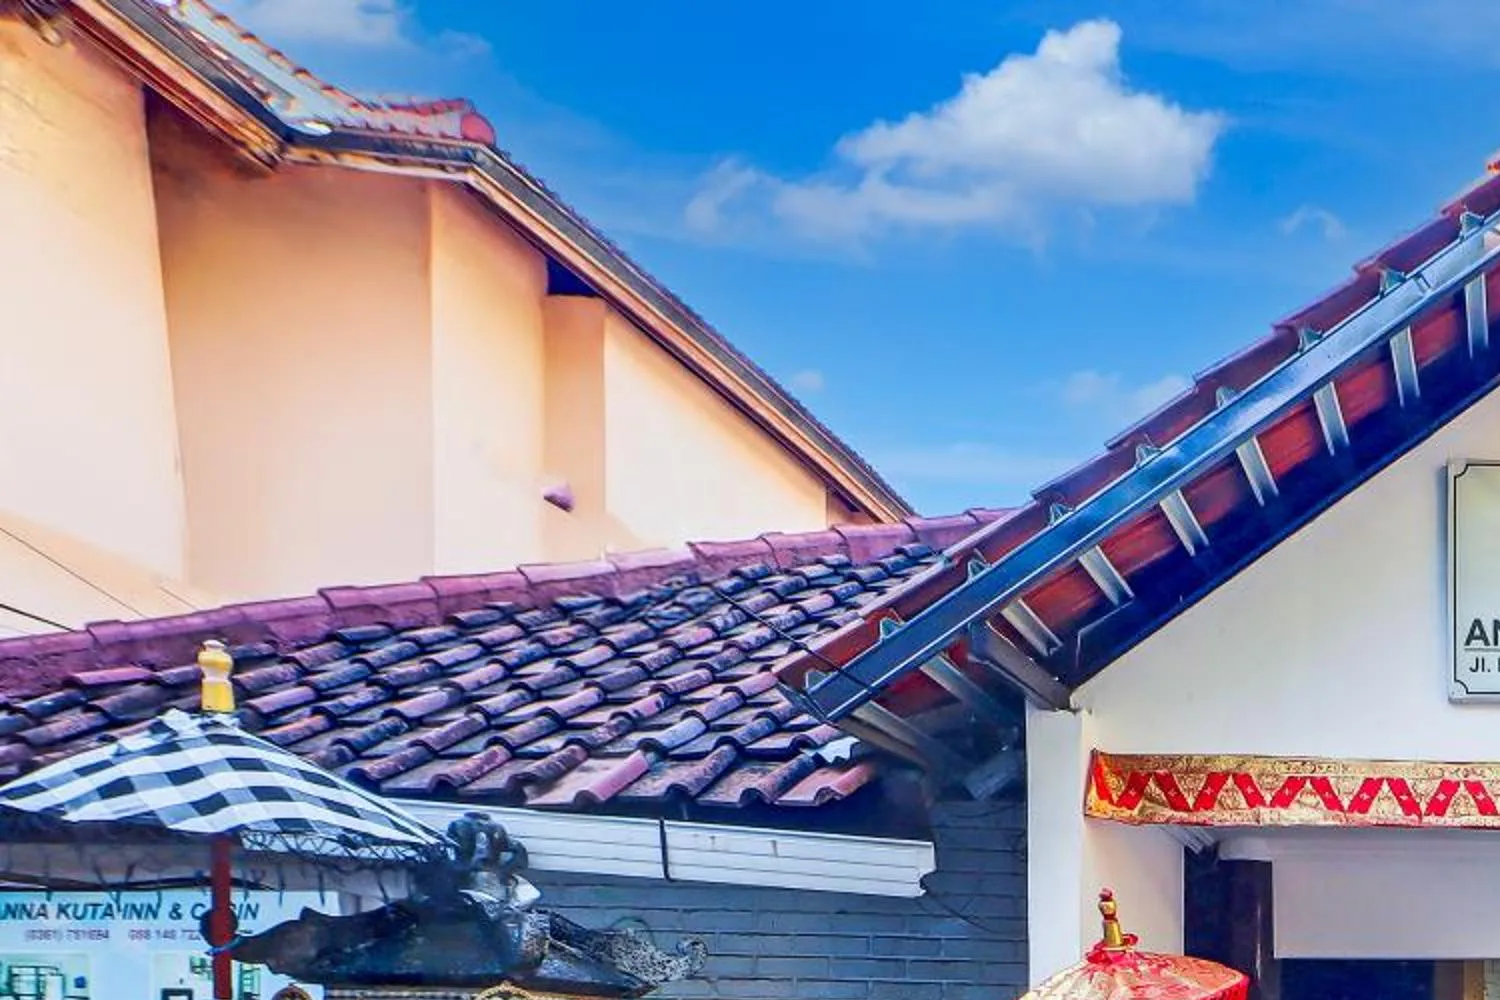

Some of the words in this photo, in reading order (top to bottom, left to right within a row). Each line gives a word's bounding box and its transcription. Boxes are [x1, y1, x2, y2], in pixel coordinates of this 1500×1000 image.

[1469, 657, 1491, 673] Jl.
[0, 903, 48, 920] NNA
[56, 903, 115, 920] KUTA
[122, 903, 159, 920] INN
[168, 902, 182, 920] &
[190, 902, 259, 920] CIN
